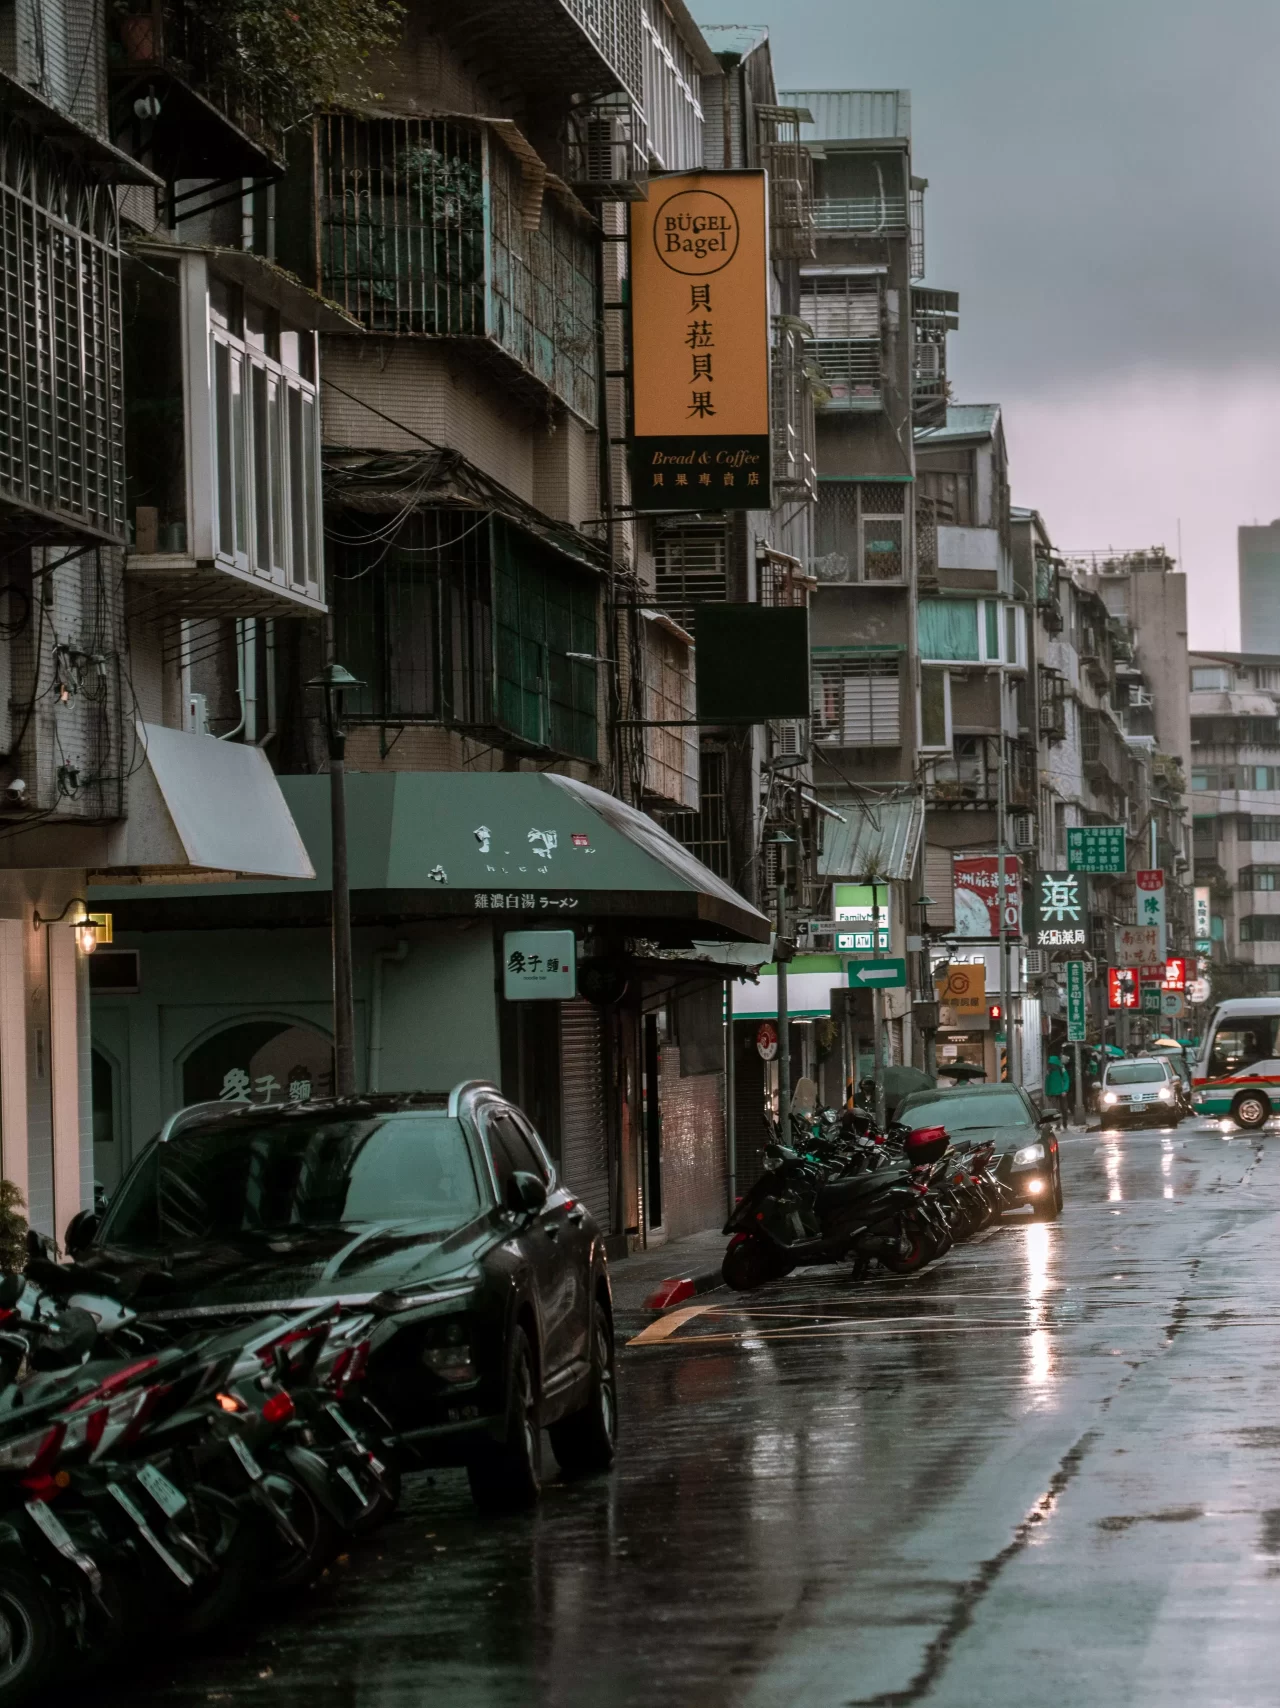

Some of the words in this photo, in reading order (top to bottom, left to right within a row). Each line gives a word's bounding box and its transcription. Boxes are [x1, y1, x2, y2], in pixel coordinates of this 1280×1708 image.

[664, 213, 732, 231] BÜGEL
[664, 231, 727, 259] Bagel
[684, 283, 717, 420] 貝菈貝果
[652, 450, 696, 465] Bread
[698, 451, 711, 465] &
[716, 450, 760, 468] Coffee
[652, 471, 760, 487] 貝果專賣店
[474, 893, 536, 909] 雞濃白湯
[539, 897, 579, 909] ラーメン
[840, 913, 886, 921] FamilyMrt
[856, 936, 869, 946] ATM
